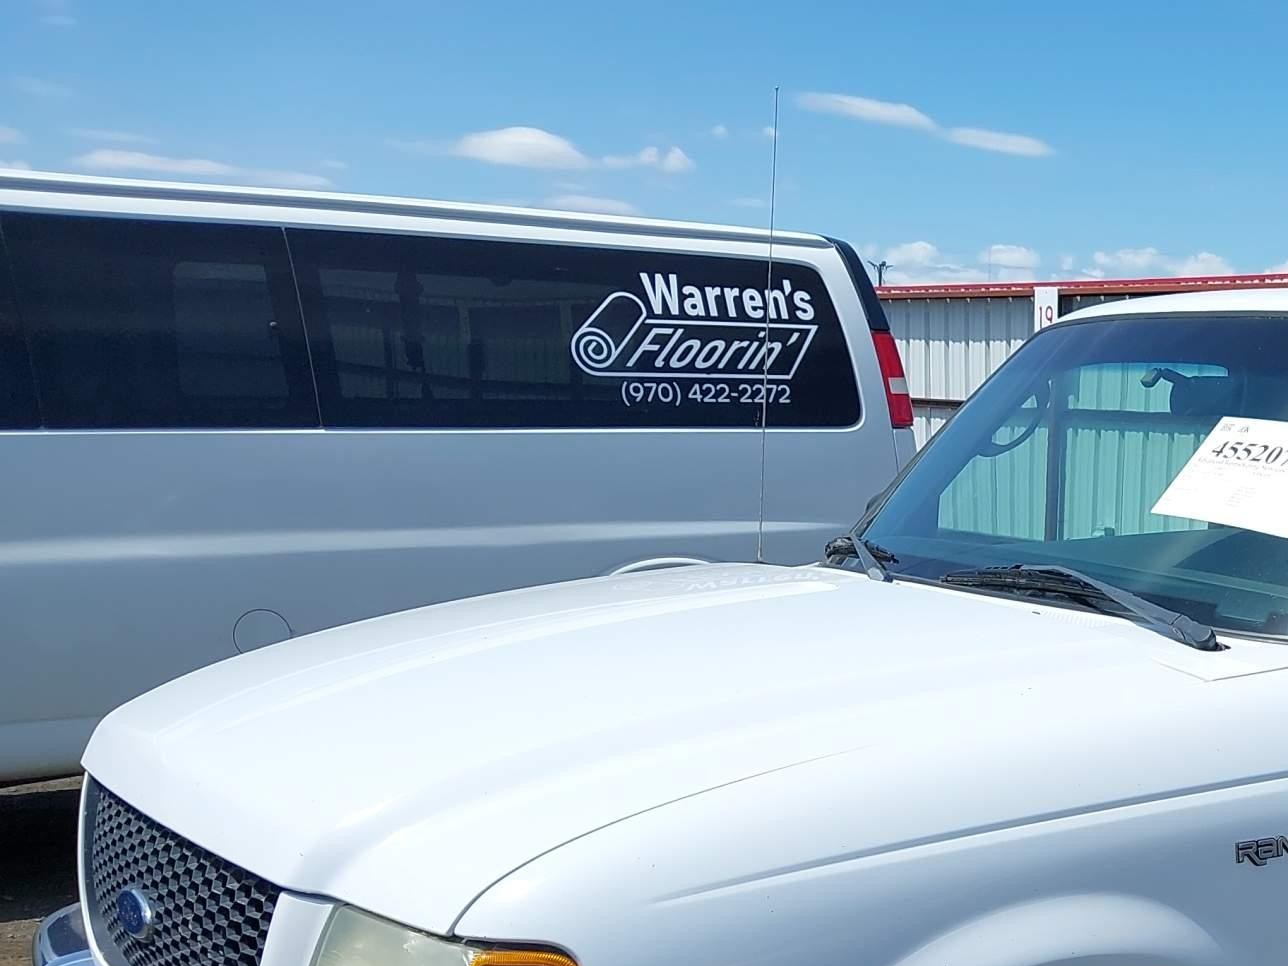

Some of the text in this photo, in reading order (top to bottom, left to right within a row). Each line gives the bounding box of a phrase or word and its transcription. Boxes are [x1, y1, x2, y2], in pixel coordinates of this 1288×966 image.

[639, 272, 815, 321] Warren's
[626, 328, 800, 370] Floorin'
[621, 381, 792, 406] (970) 422-2272
